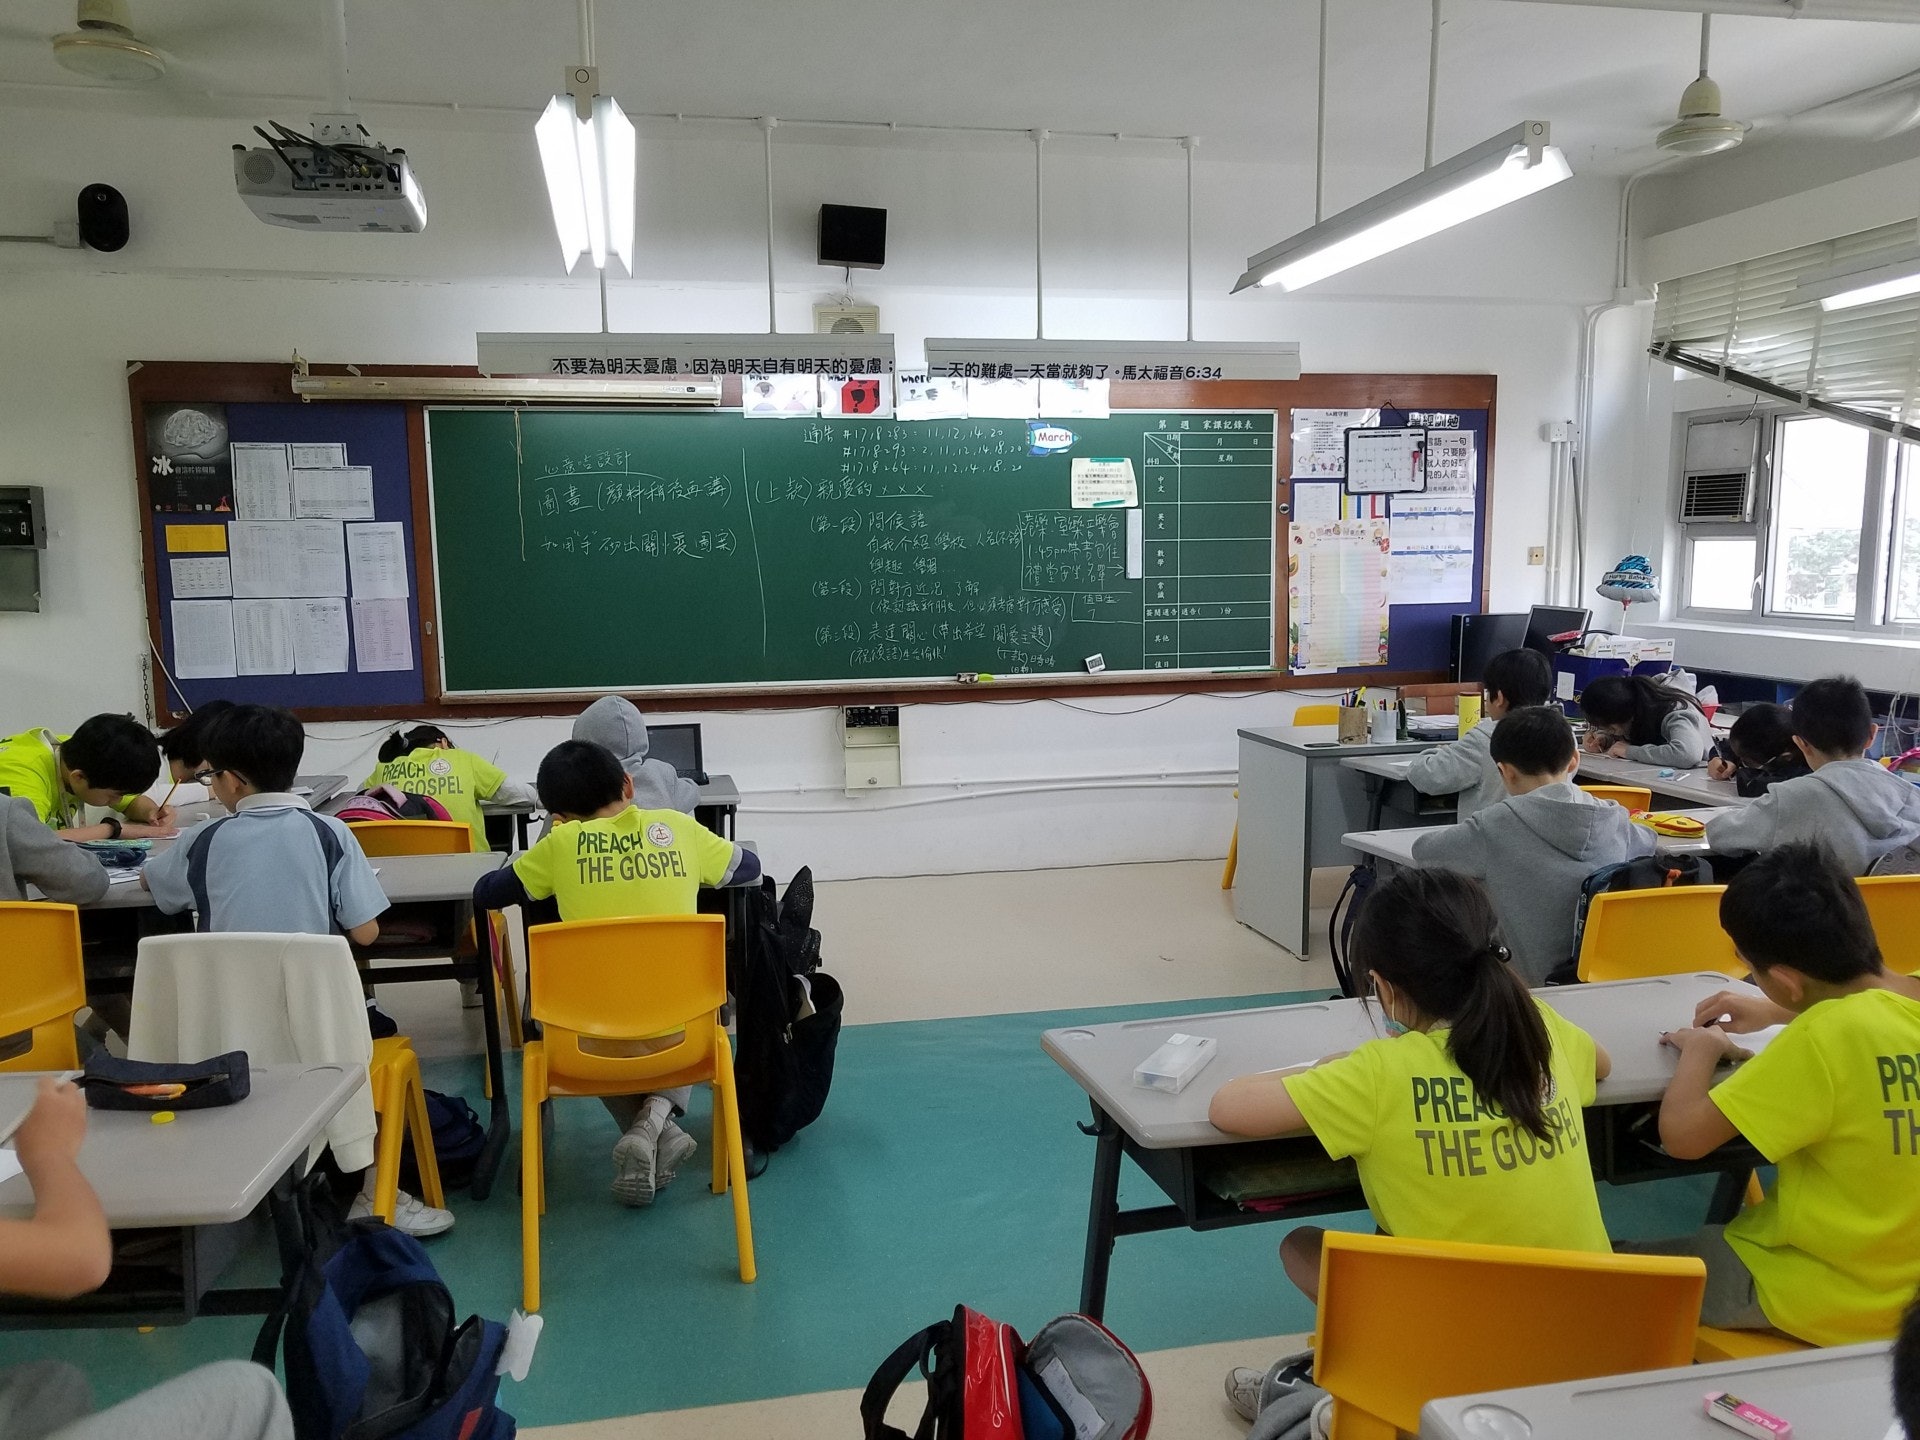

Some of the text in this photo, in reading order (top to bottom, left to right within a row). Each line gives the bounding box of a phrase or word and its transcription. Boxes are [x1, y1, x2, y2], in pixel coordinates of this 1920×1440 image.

[1158, 419, 1167, 430] 第
[1038, 432, 1071, 442] March
[1216, 438, 1259, 446] 月 日
[152, 455, 174, 476] 冰
[1217, 454, 1234, 463] 星期
[1157, 475, 1165, 493] 中文
[1157, 513, 1165, 530] 英文
[1157, 549, 1165, 567] 數學
[1157, 581, 1165, 599] 常識
[1154, 635, 1170, 643] 其他
[382, 761, 426, 782] PREACH
[403, 776, 464, 795] GOSPEL
[577, 831, 643, 856] PREACH
[576, 850, 687, 884] THE GOSPEL
[1876, 1052, 1920, 1103] PR
[1415, 1129, 1487, 1177] THE
[1744, 1410, 1778, 1430] PLUS
